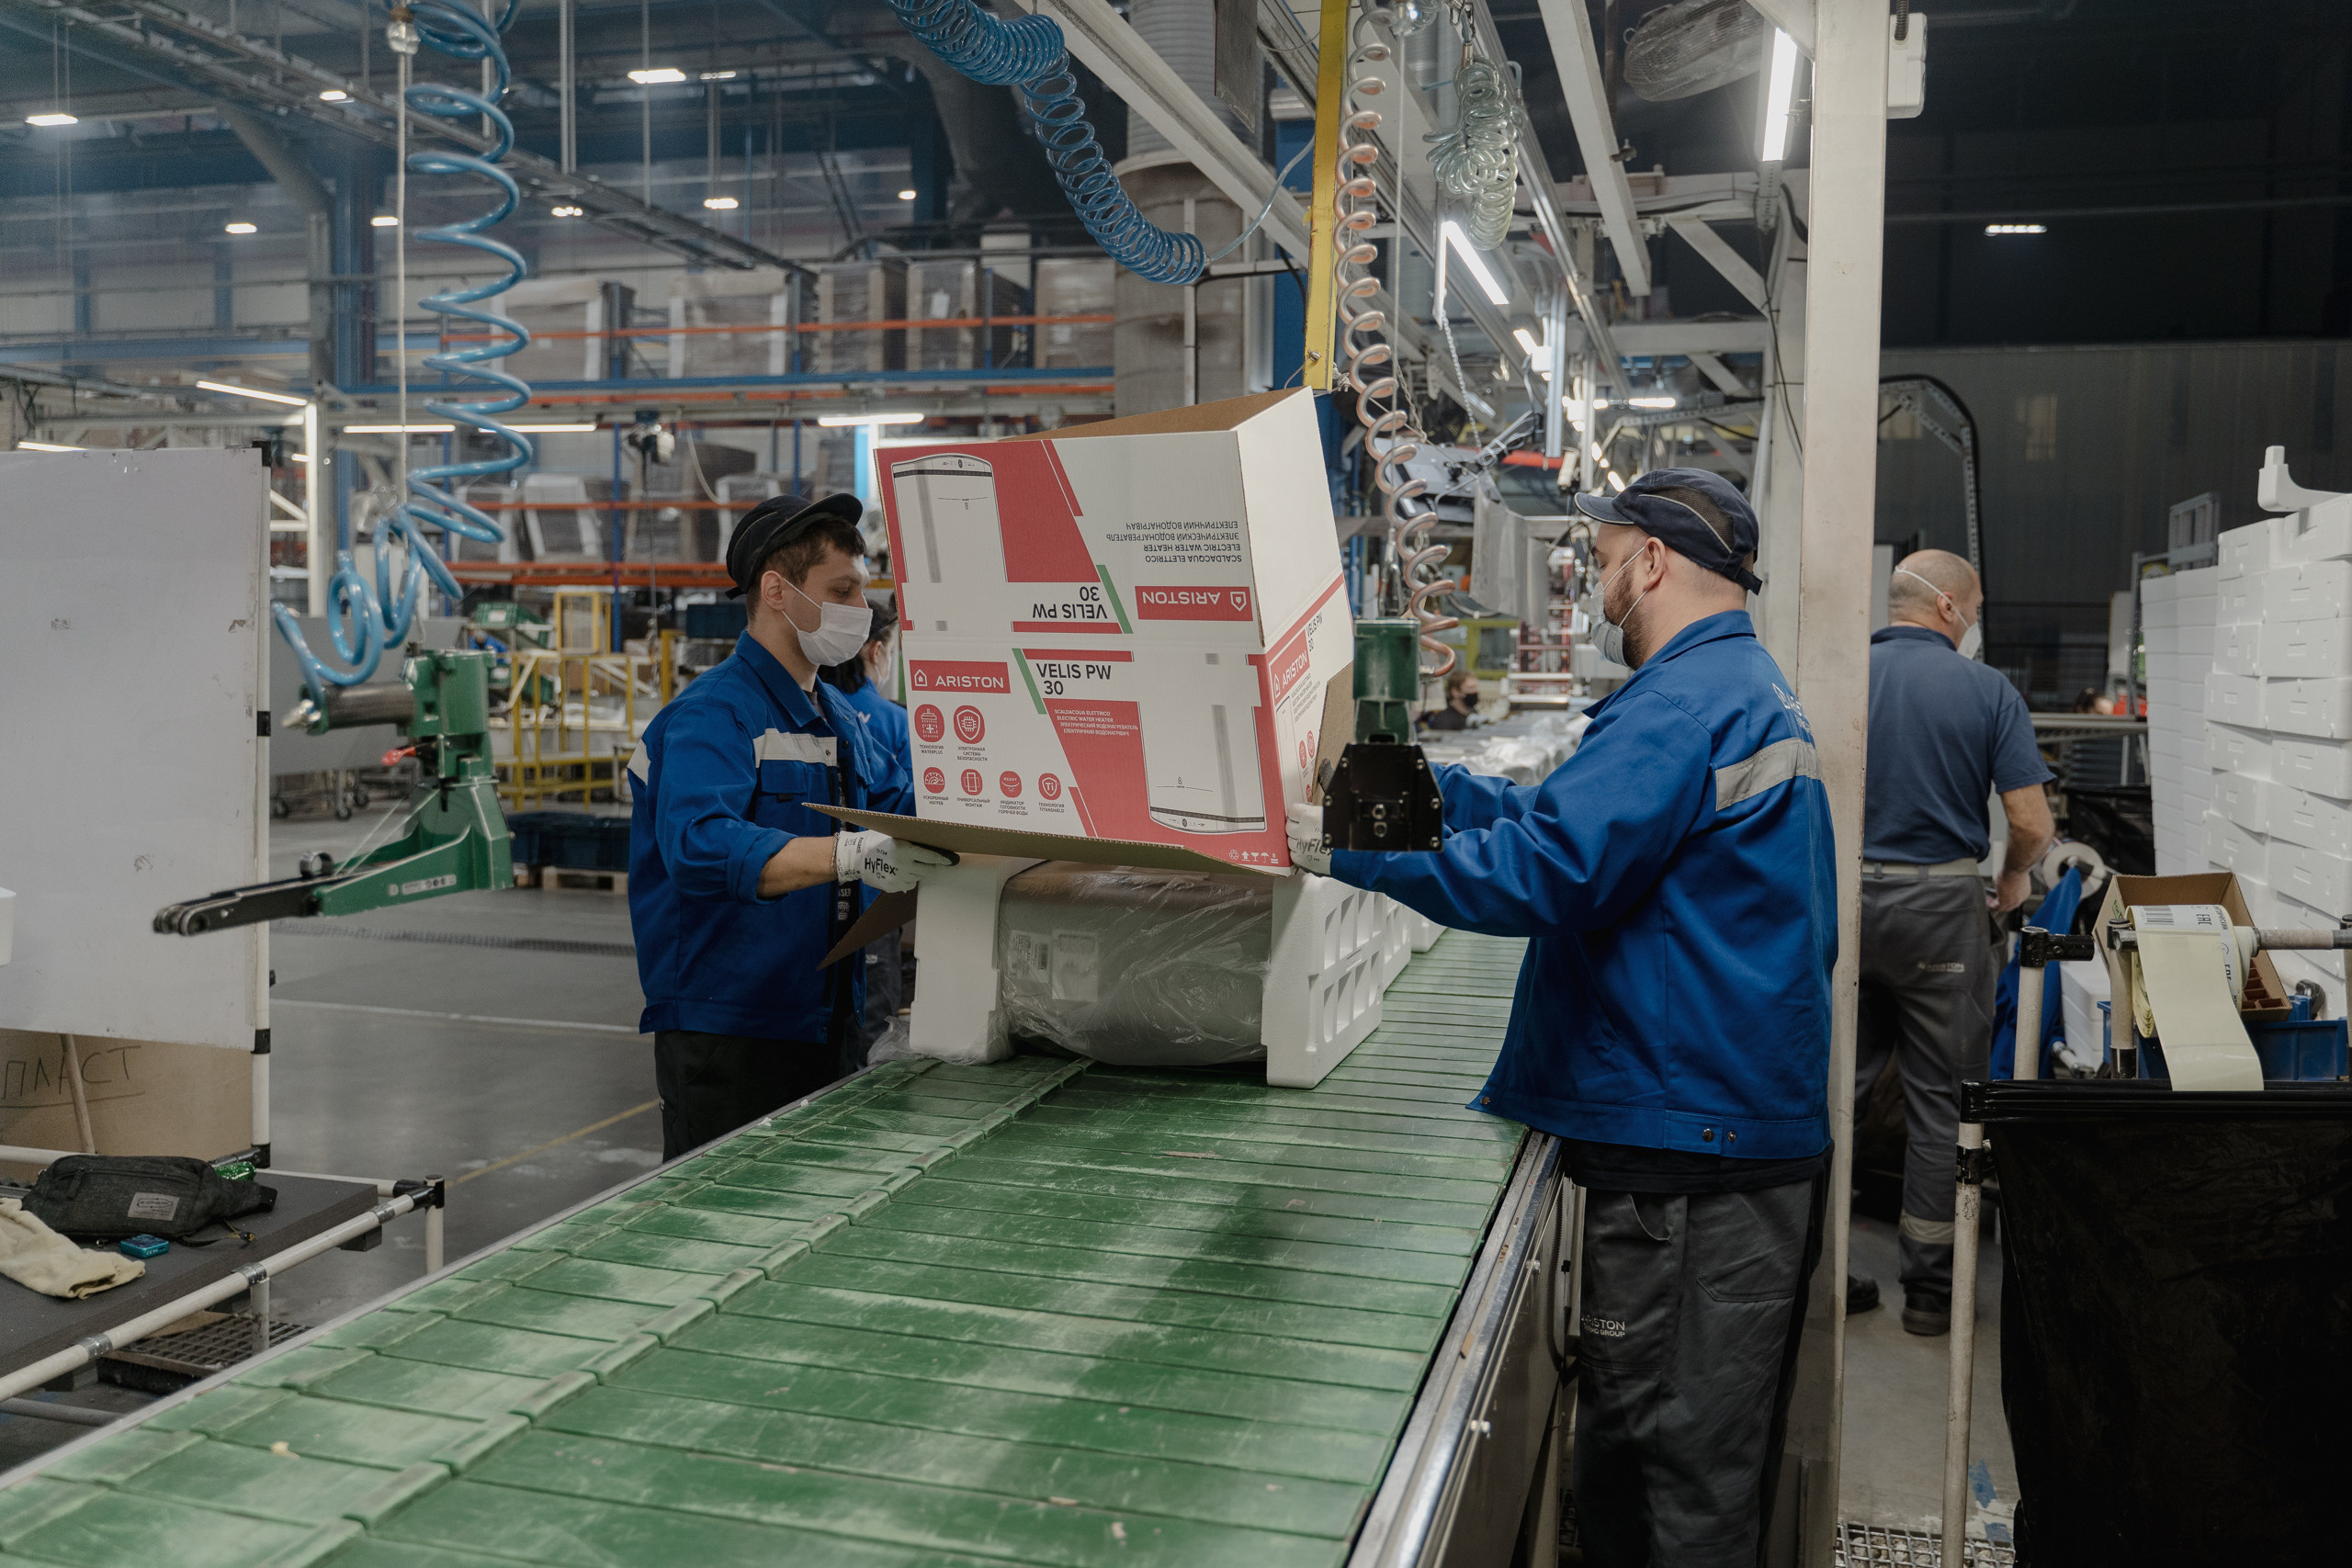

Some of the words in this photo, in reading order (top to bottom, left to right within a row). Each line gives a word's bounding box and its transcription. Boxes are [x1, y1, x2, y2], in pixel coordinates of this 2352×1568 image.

[1125, 522, 1182, 530] ВОДОНАГРІВАЧ
[1183, 521, 1238, 529] ЕЛЕКТРИЧНИЙ
[1106, 533, 1175, 542] ВОДОНАГРЕВАТЕЛЬ
[1176, 532, 1239, 541] ЭЛЕКТРИЧЕСКИЙ
[1145, 555, 1186, 563] ELETTRICO
[1188, 555, 1242, 563] SCALDACQUA
[1080, 586, 1100, 602] 30
[1142, 592, 1220, 605] ARISTON
[1032, 604, 1057, 618] PW
[1062, 604, 1108, 619] VELIS
[1036, 663, 1081, 679] VELIS
[1086, 664, 1112, 680] PW
[1282, 649, 1308, 689] ARISTON
[935, 675, 1004, 689] ARISTON
[1044, 681, 1064, 695] 30
[1045, 782, 1055, 791] Ti
[865, 857, 897, 876] HyFlex
[1600, 1329, 1625, 1337] GROUP
